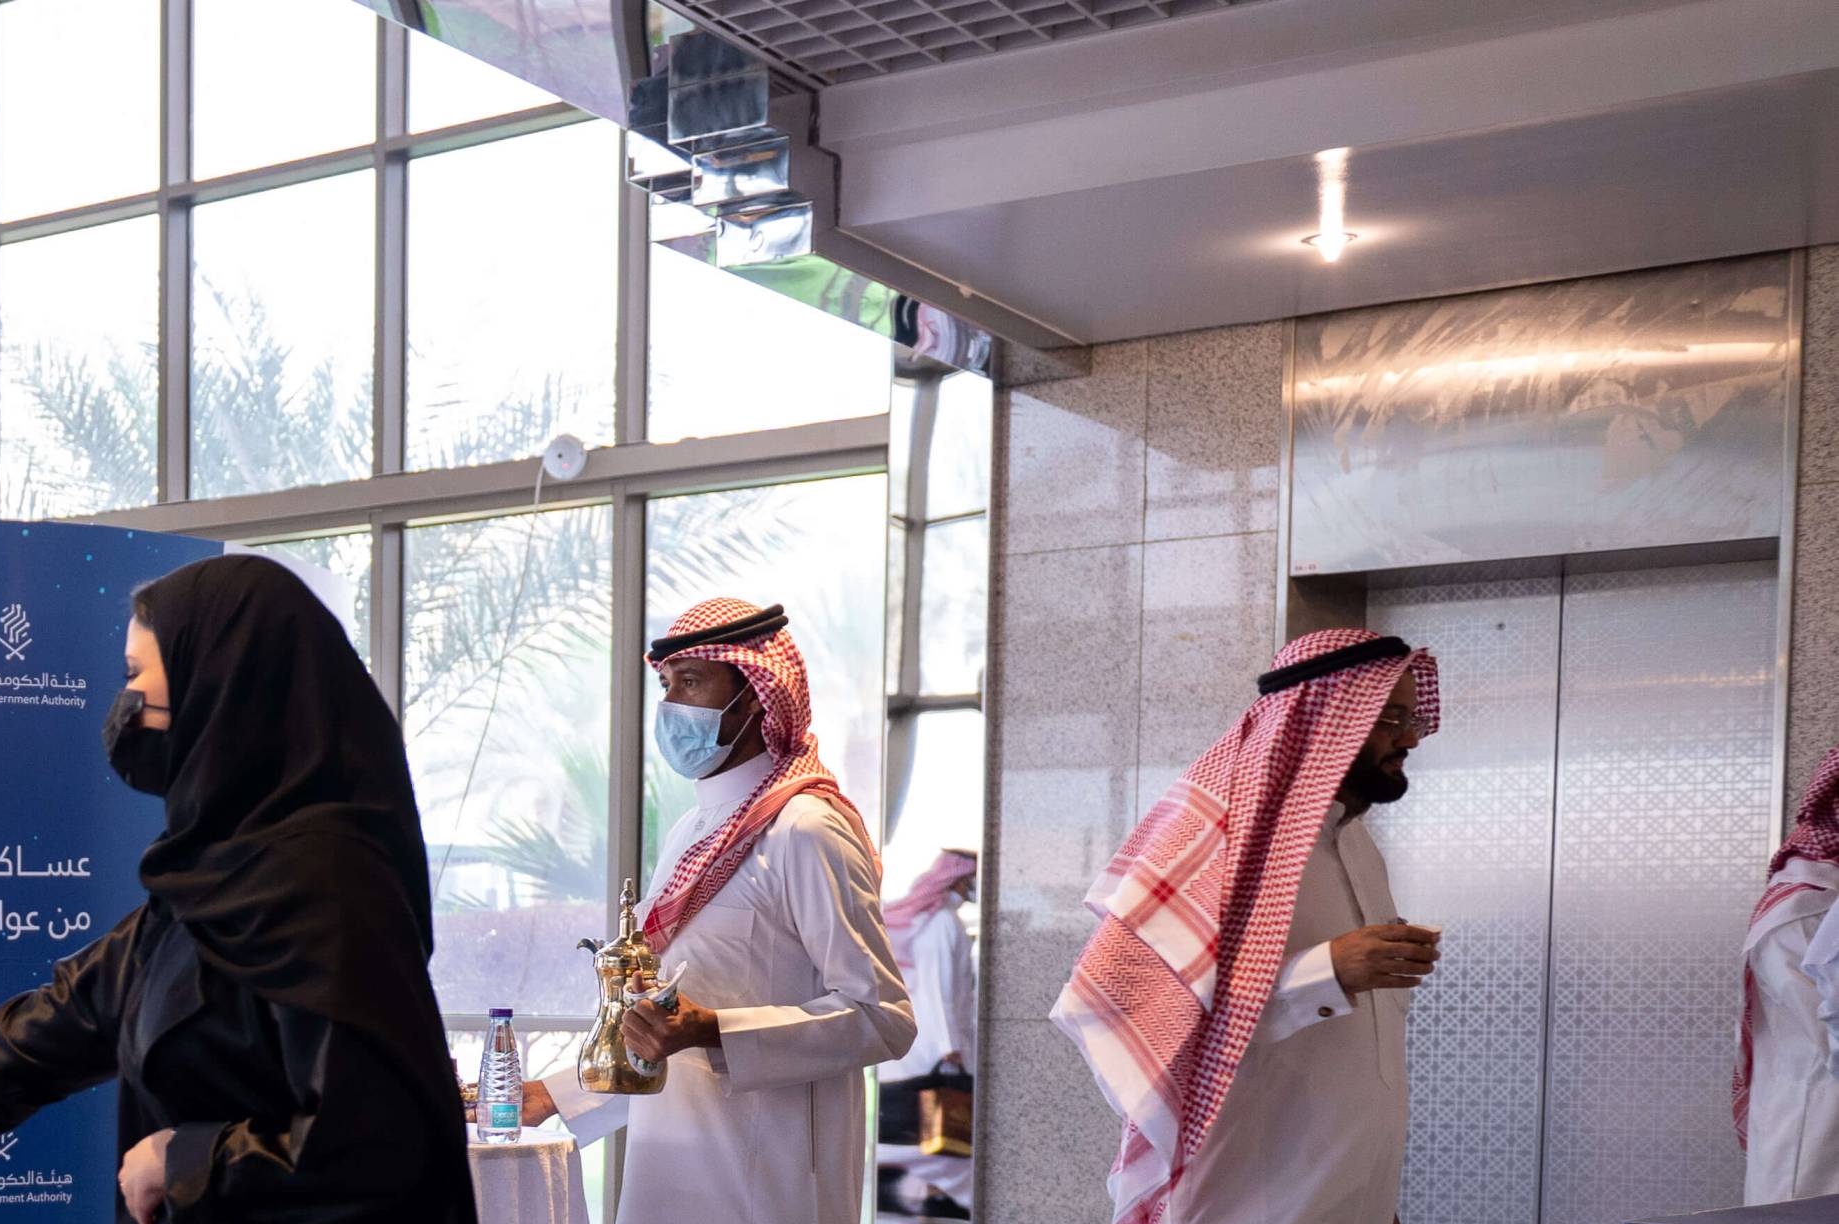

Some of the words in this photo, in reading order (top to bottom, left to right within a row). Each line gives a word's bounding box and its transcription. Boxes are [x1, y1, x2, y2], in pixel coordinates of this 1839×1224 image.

[50, 672, 87, 692] هيئة
[41, 695, 86, 709] Authority
[48, 907, 91, 939] من
[35, 1169, 73, 1188] هيئة
[26, 1191, 73, 1204] Authority
